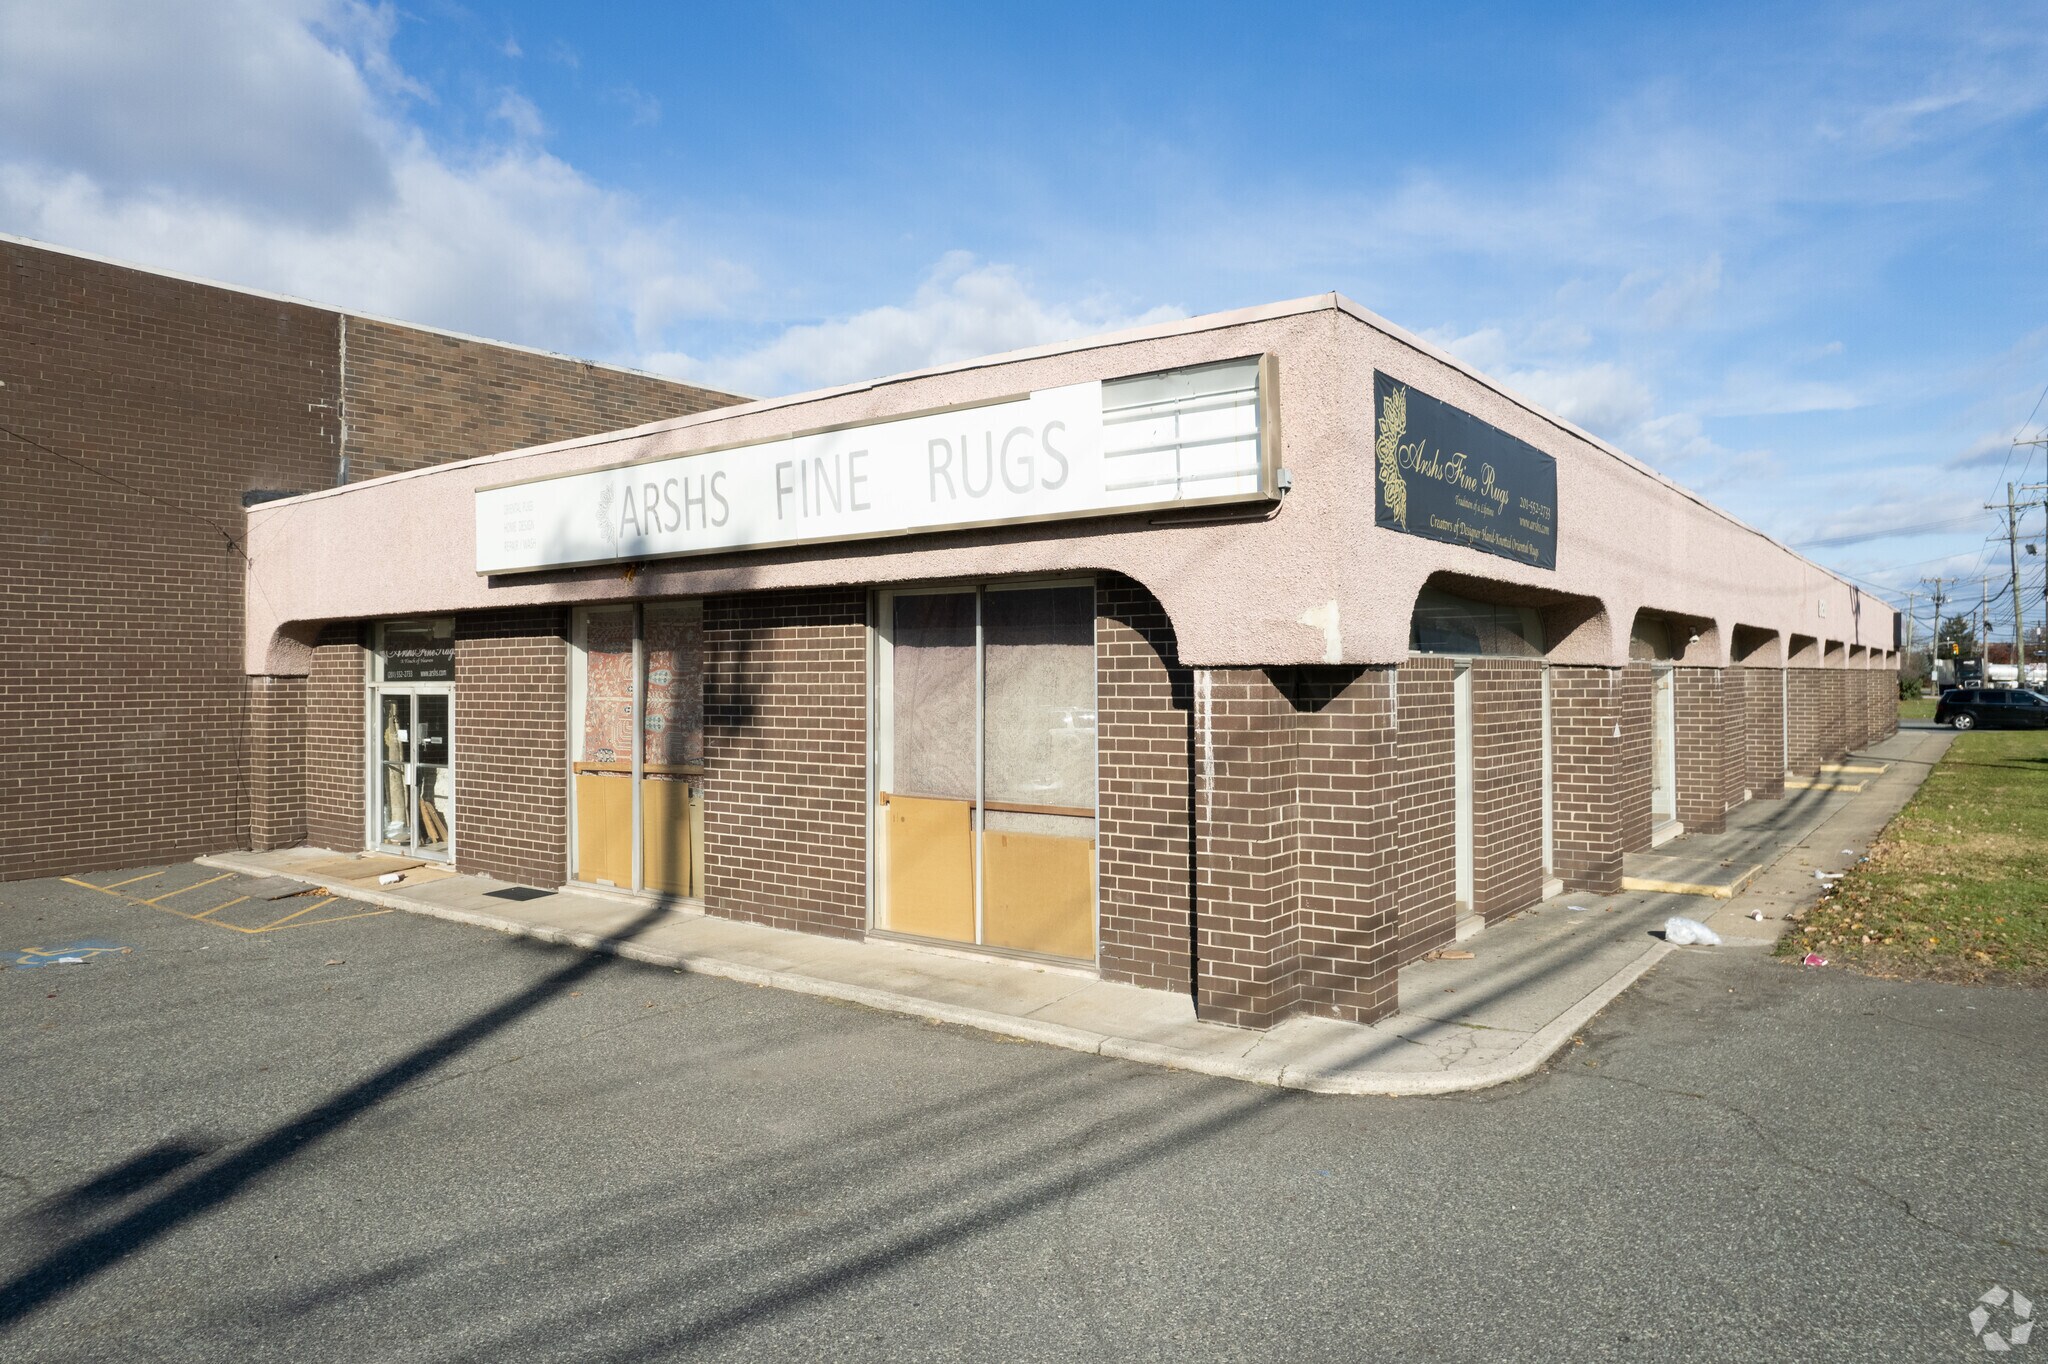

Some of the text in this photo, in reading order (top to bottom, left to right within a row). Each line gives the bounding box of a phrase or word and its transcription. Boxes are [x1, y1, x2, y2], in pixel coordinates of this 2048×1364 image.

[619, 420, 1069, 538] ARSHS FINE RUGS
[1399, 439, 1510, 515] Arshs Fine Rugs
[1453, 517, 1461, 539] of
